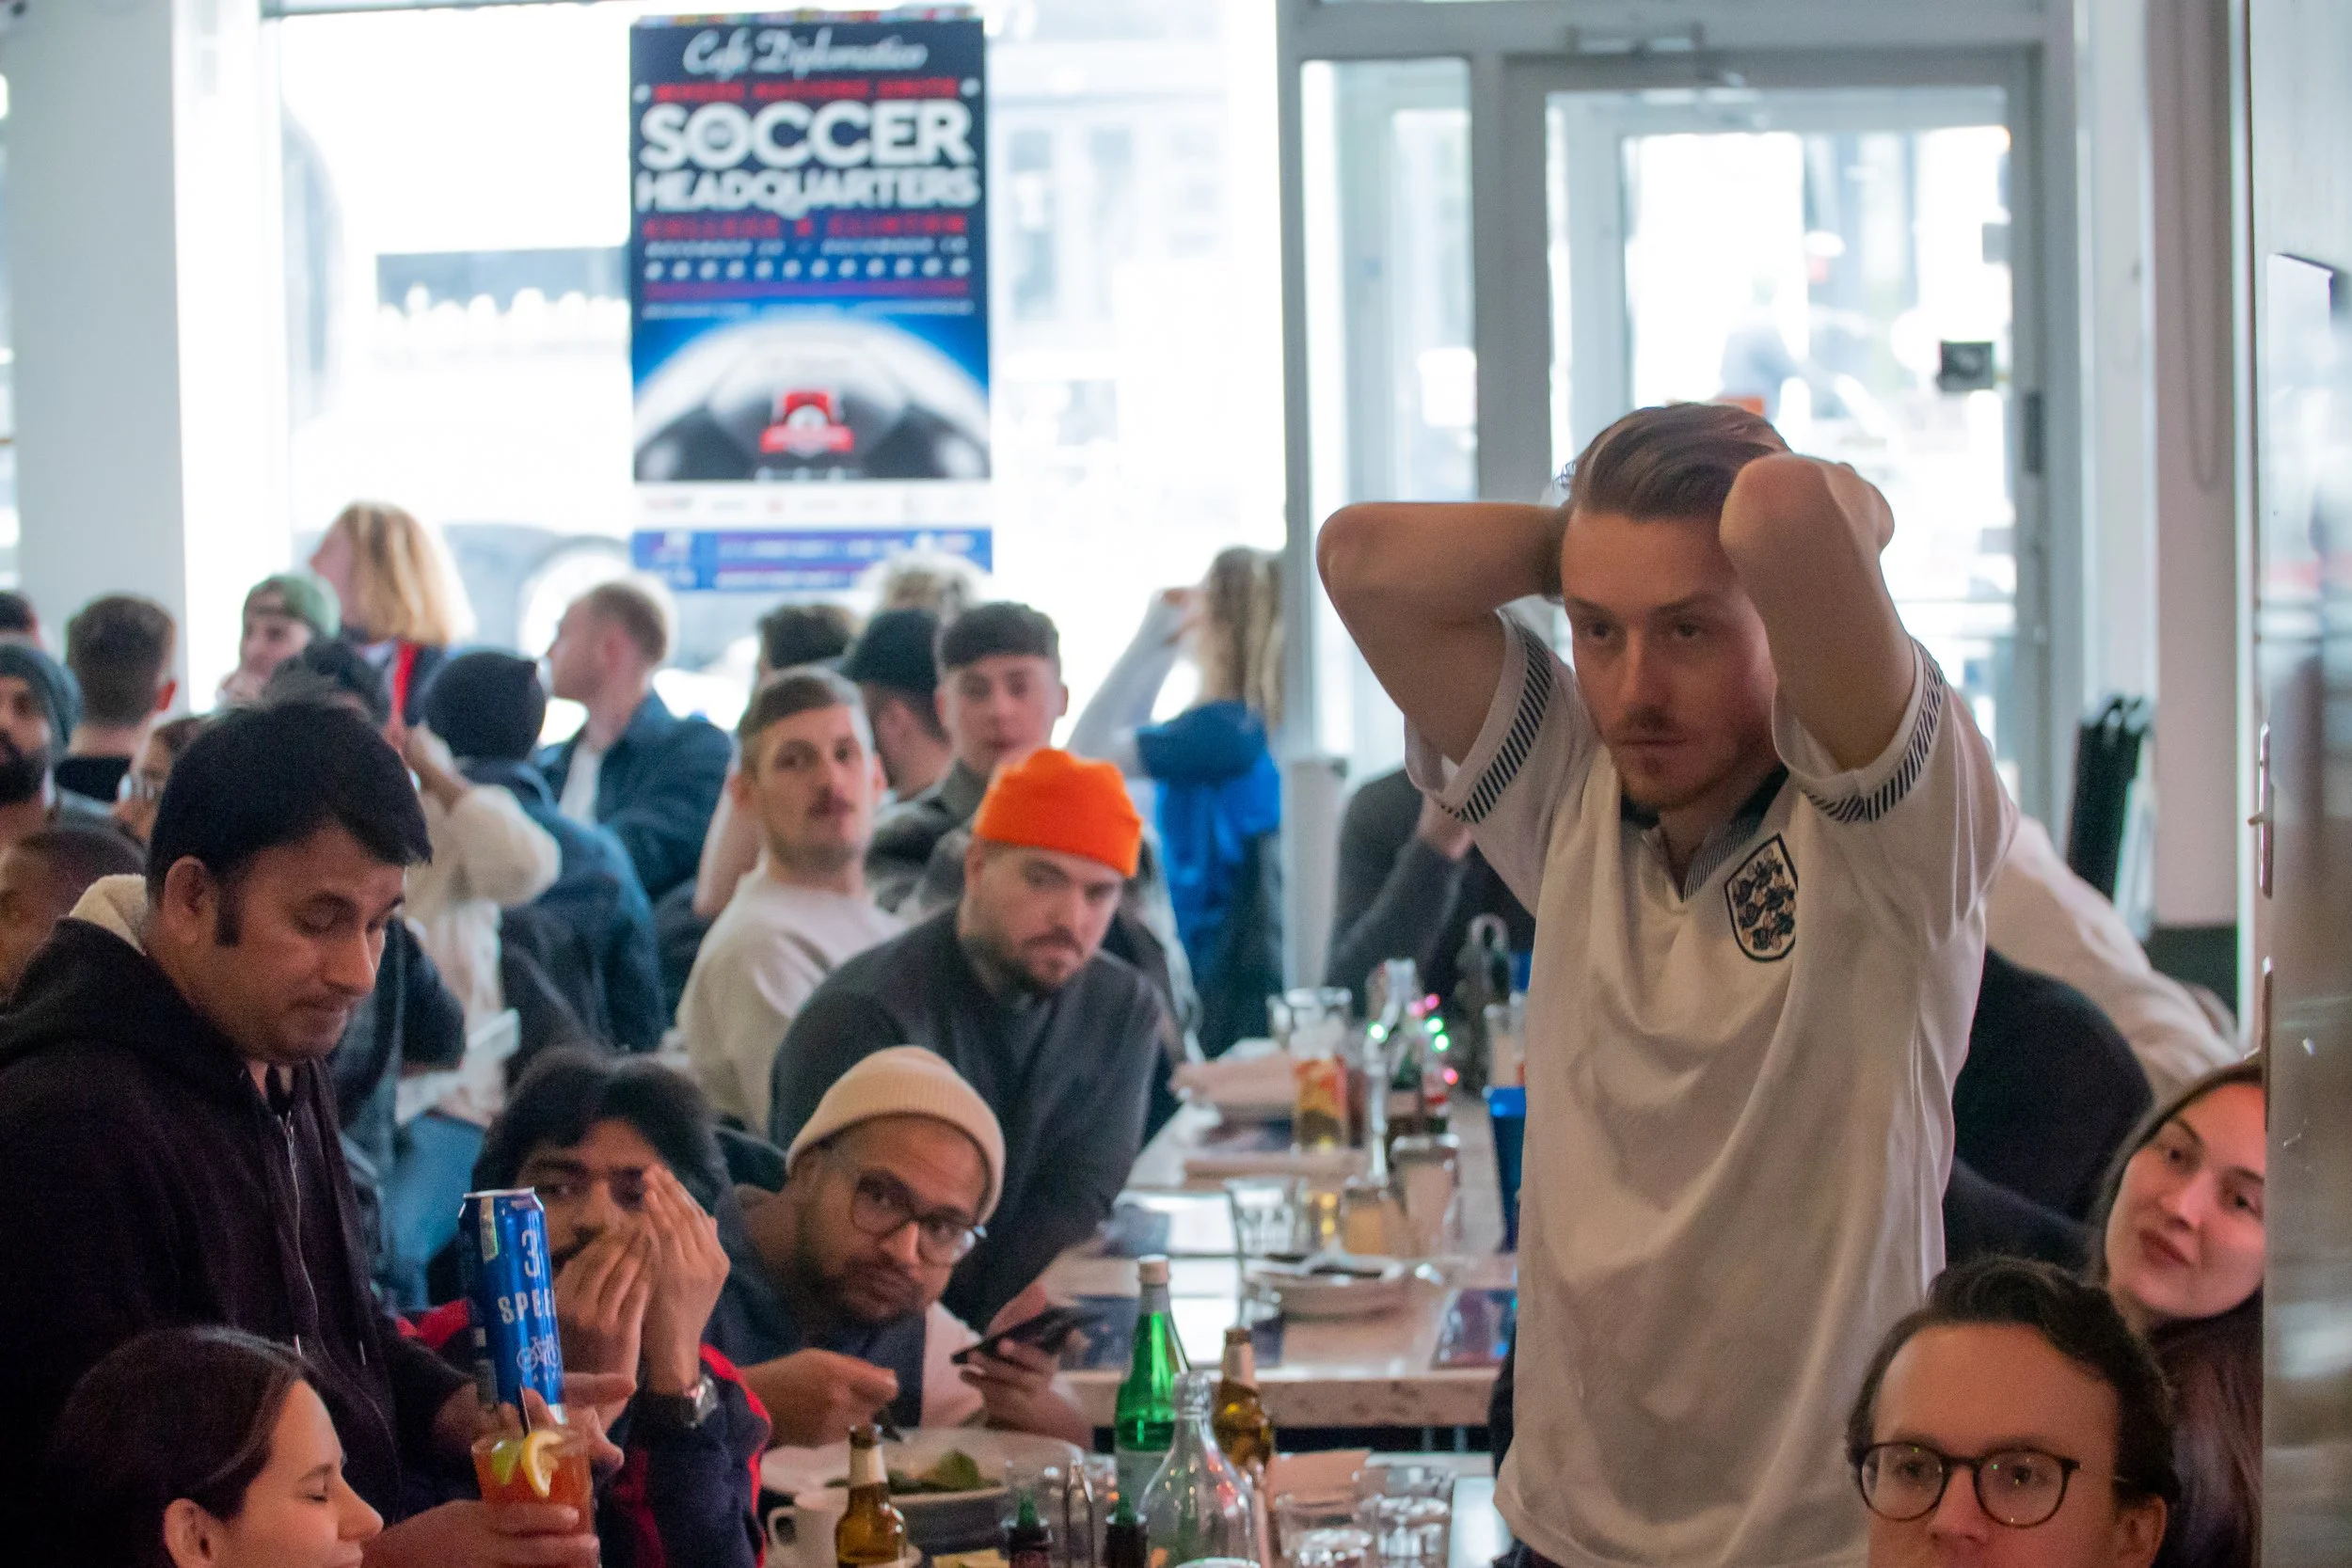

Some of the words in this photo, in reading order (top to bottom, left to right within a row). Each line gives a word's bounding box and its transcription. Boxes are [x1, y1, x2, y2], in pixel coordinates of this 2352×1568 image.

[640, 102, 976, 171] SOCCER
[636, 167, 980, 218] HEADQUARTERS
[522, 1230, 540, 1276] 3
[499, 1290, 557, 1324] SPEE
